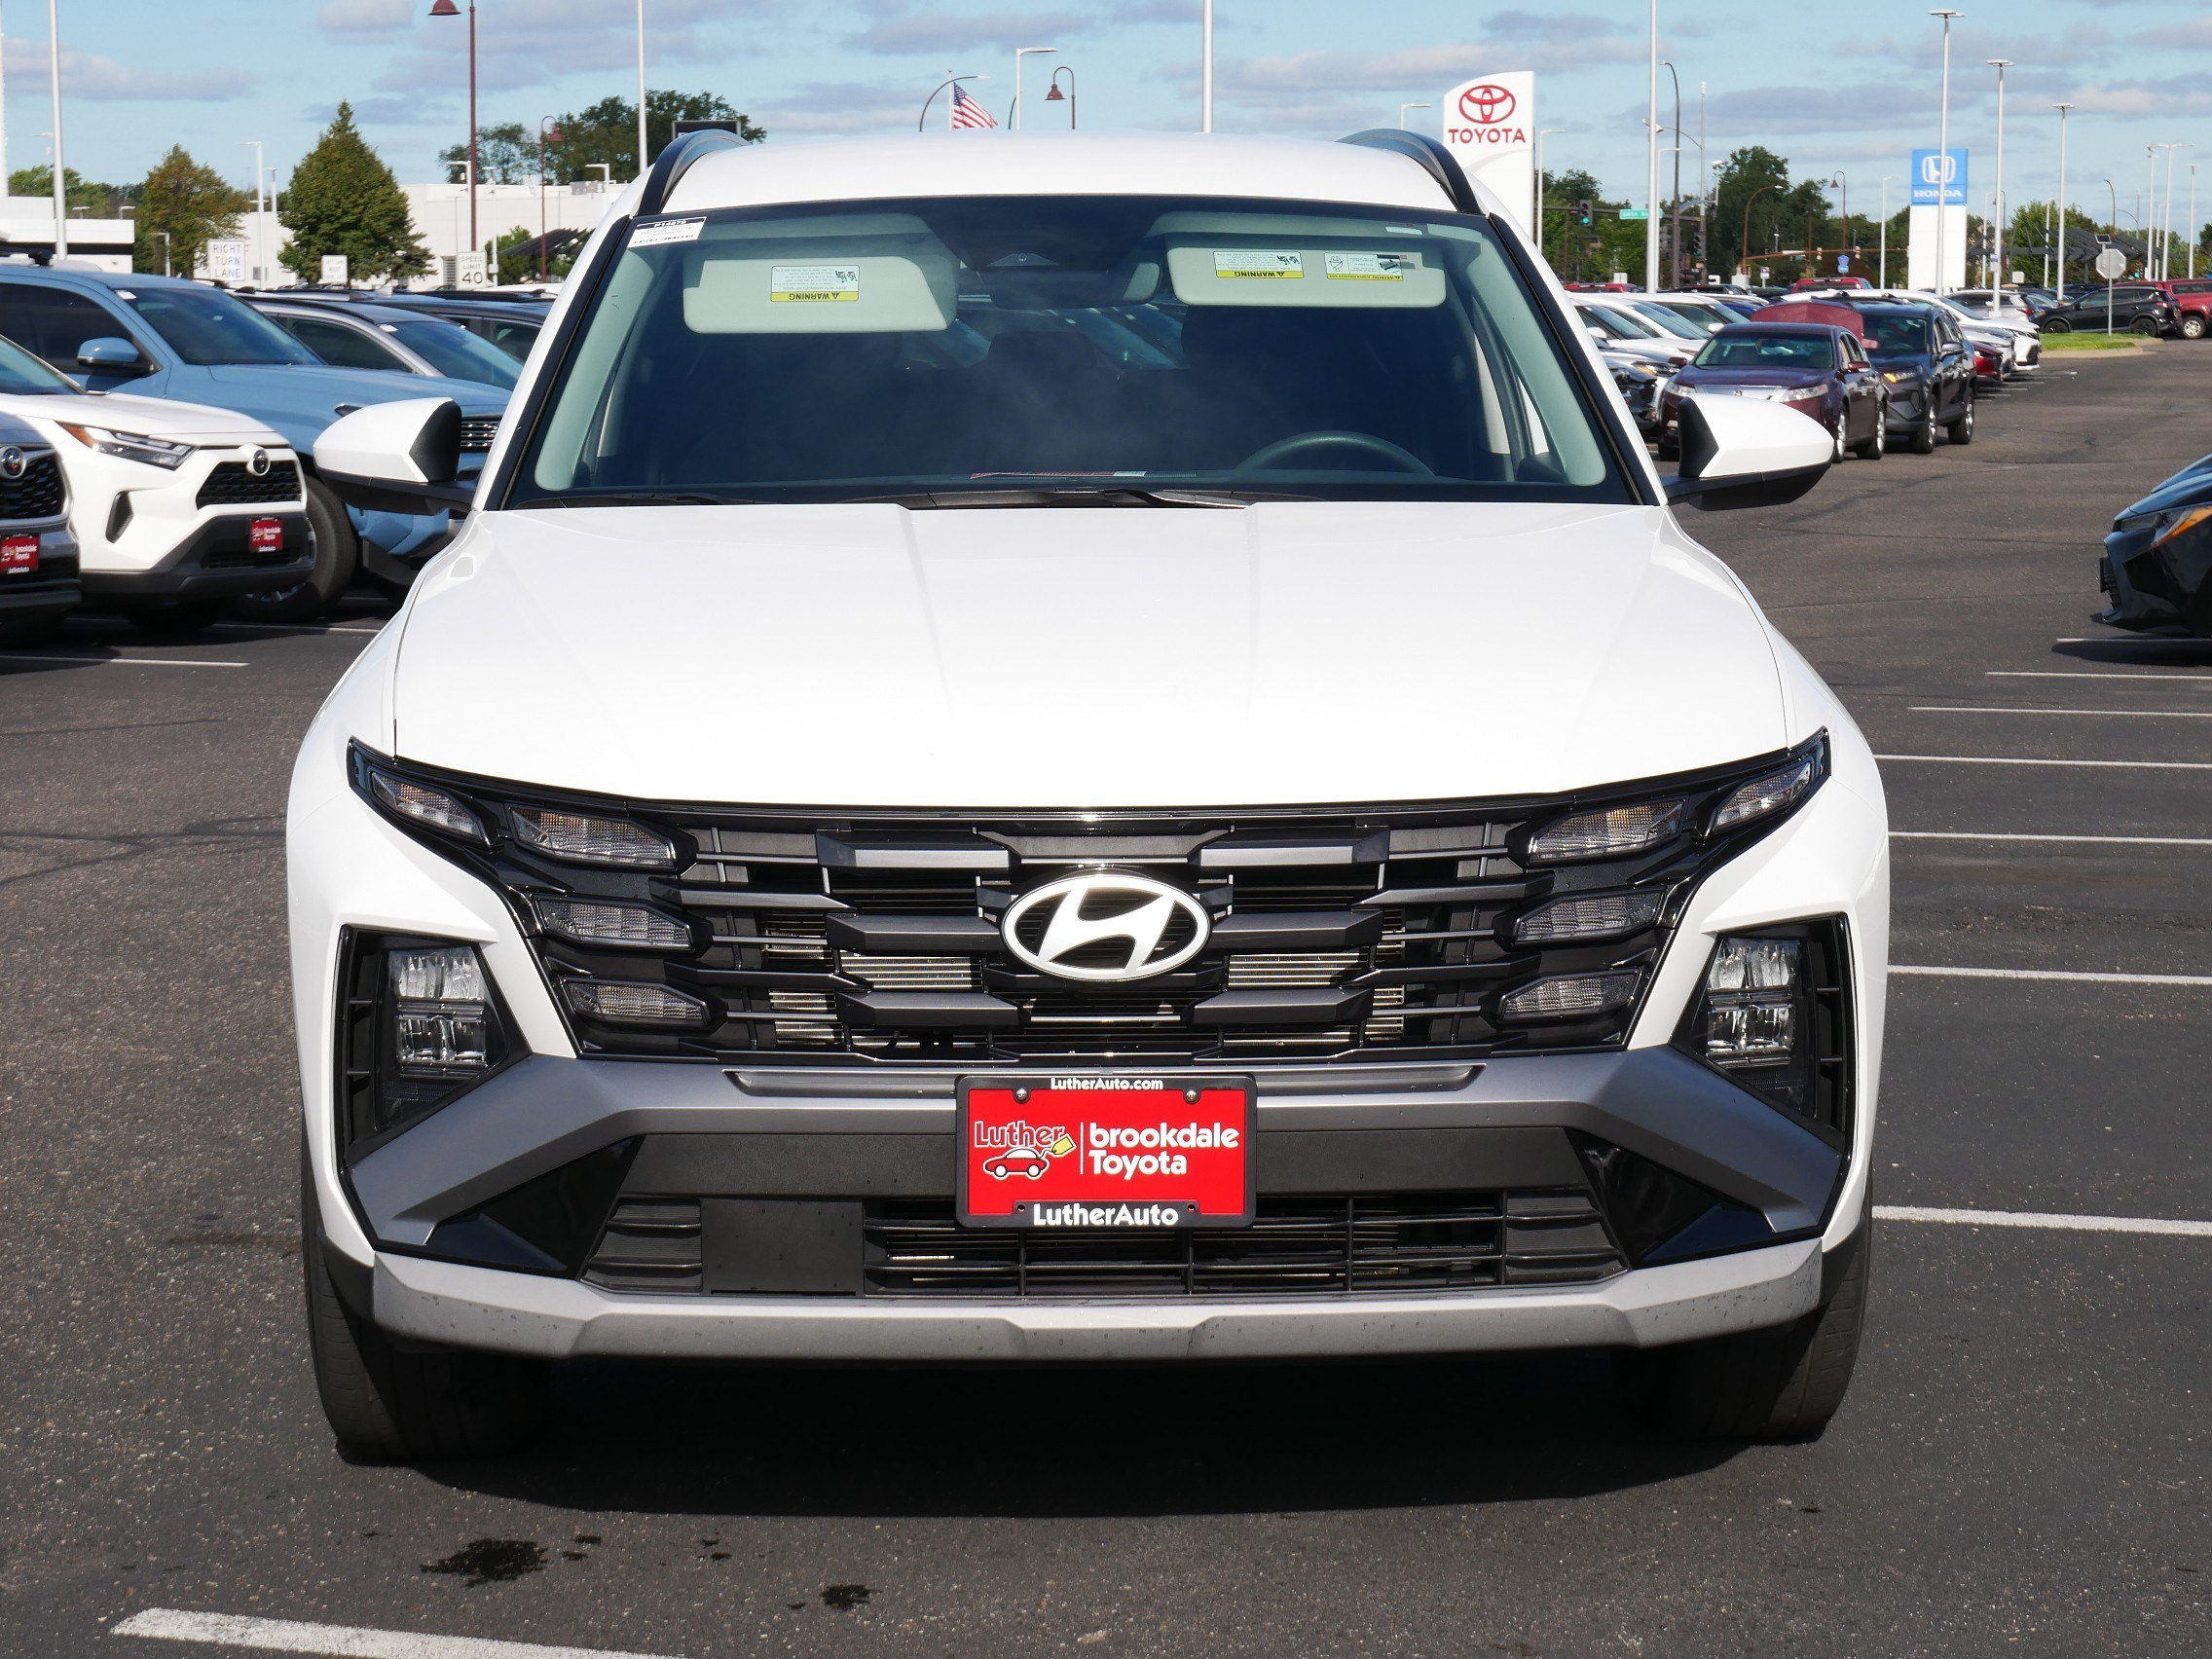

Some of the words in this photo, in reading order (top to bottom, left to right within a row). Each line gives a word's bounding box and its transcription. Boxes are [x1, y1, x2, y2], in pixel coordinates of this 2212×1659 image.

[1448, 129, 1527, 143] TOYOTA
[213, 243, 241, 254] RIGHT
[215, 256, 241, 266] TURN
[215, 268, 240, 277] LANE
[461, 271, 483, 284] 40
[789, 292, 830, 301] WARNING
[1051, 1077, 1163, 1090] LutherAuto.com
[974, 1121, 1066, 1148] Luther
[1089, 1122, 1239, 1149] brookdale
[1088, 1149, 1187, 1181] Toyota
[1033, 1203, 1179, 1226] LutherAuto
